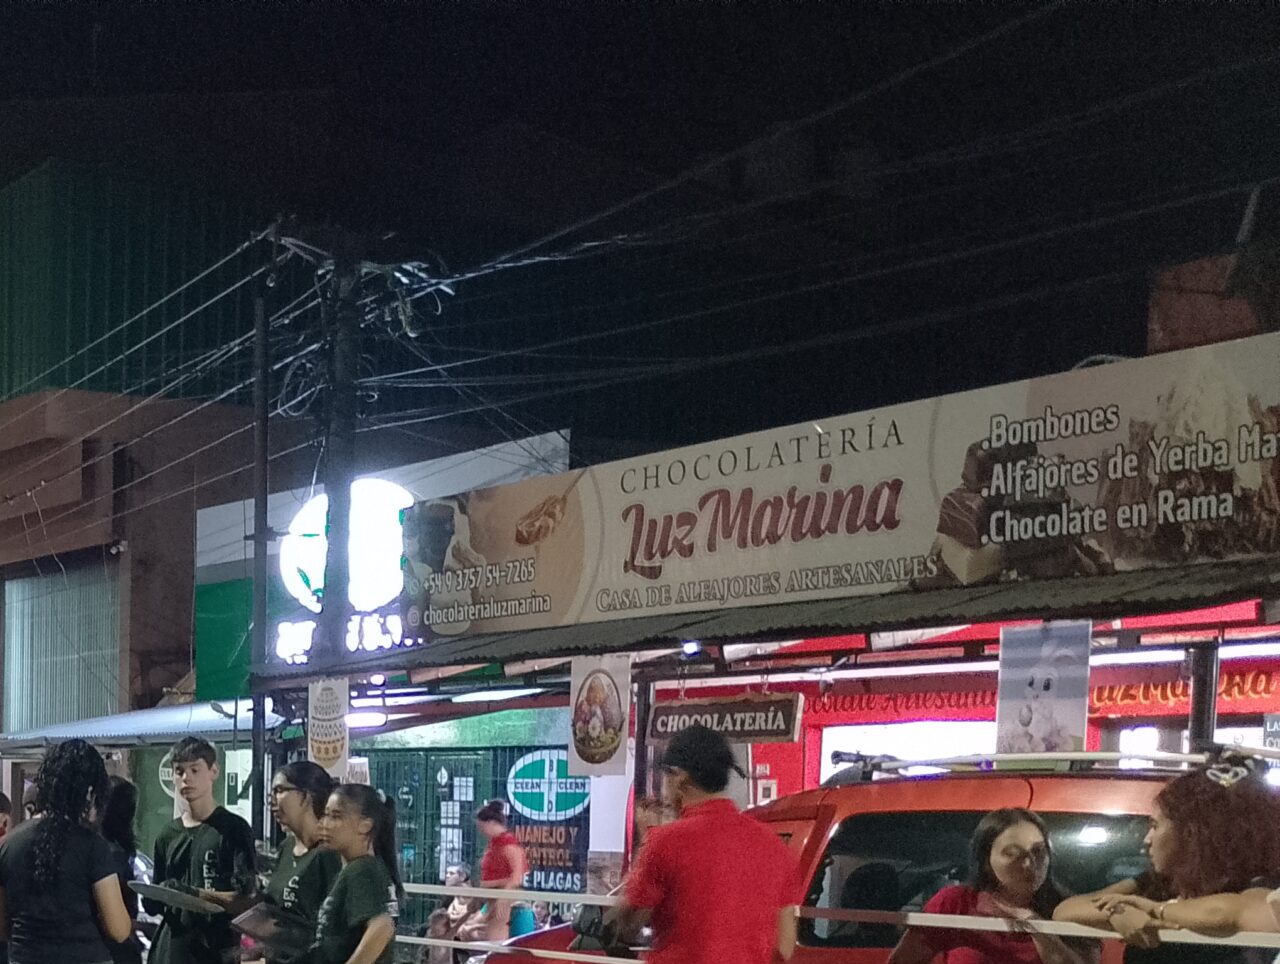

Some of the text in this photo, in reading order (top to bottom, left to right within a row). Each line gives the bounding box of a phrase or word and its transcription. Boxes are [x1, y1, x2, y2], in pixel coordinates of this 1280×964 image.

[621, 417, 904, 494] CHOCOLATERÍA
[1107, 445, 1139, 480] de
[1148, 430, 1230, 475] Yerba
[621, 463, 905, 580] Luz Marina
[1116, 502, 1148, 529] en
[1157, 489, 1234, 525] Rama
[423, 571, 443, 595] +54
[445, 571, 453, 591] 9
[456, 567, 483, 591] 3757
[596, 554, 940, 613] CASA DE ALFAJORES ARTESANALES
[423, 590, 552, 625] chocolaterialuzmarina
[656, 706, 786, 733] CHOCOLATERÍA
[515, 780, 586, 791] CLEAN CLEAN
[515, 825, 579, 846] MANEJO Y
[524, 846, 574, 867] NTROL
[534, 870, 582, 892] PLAGAS
